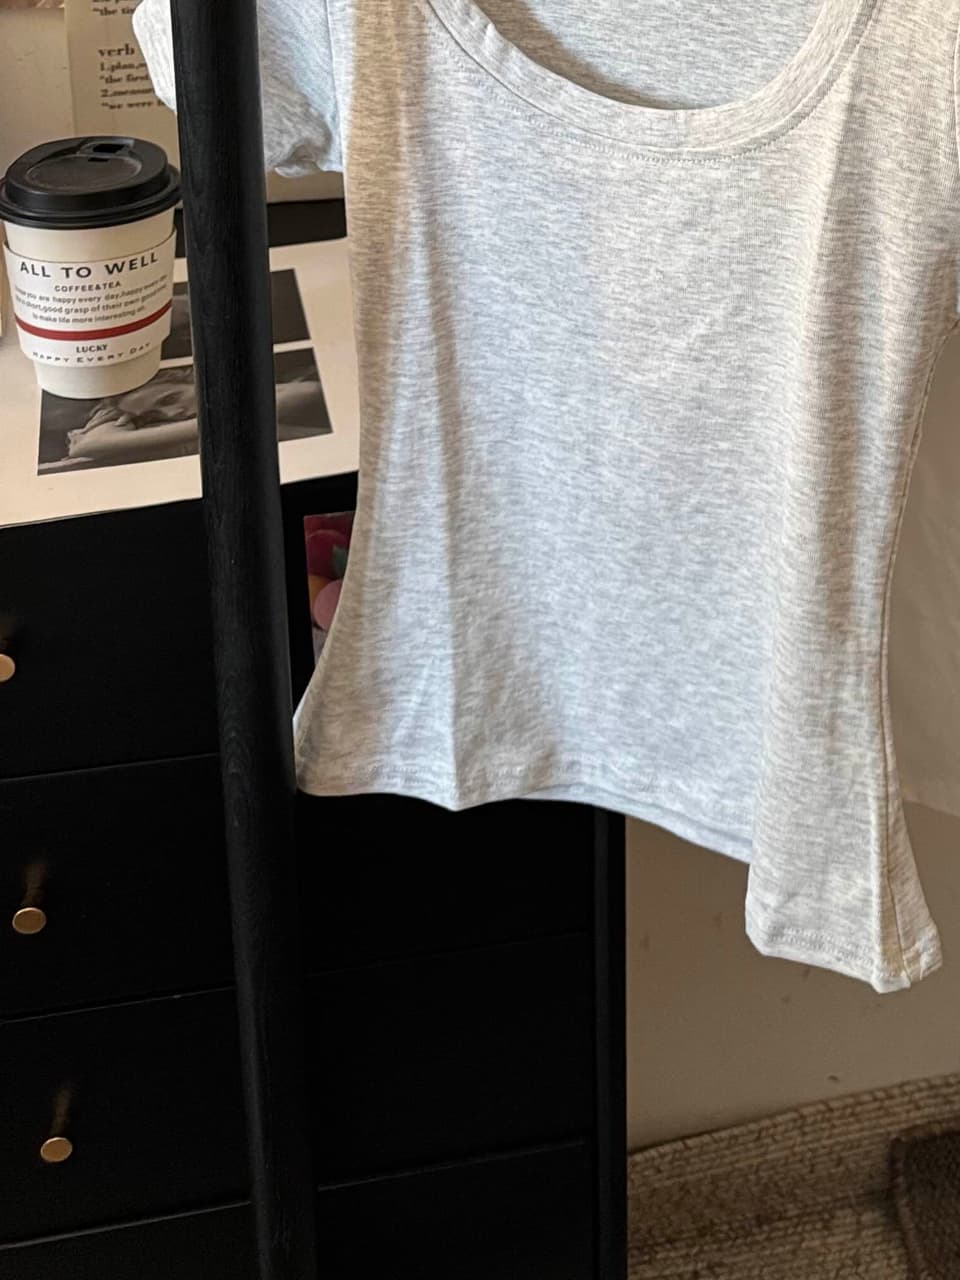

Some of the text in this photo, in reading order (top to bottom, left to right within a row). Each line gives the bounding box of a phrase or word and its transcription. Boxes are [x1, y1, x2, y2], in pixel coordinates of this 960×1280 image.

[98, 43, 134, 57] verb
[20, 252, 158, 278] ALL TO WELL
[54, 280, 122, 293] COFFEE&TEA
[52, 293, 77, 304] happy
[65, 305, 89, 315] grasp
[75, 343, 108, 353] LUCKY
[129, 342, 151, 354] DAY
